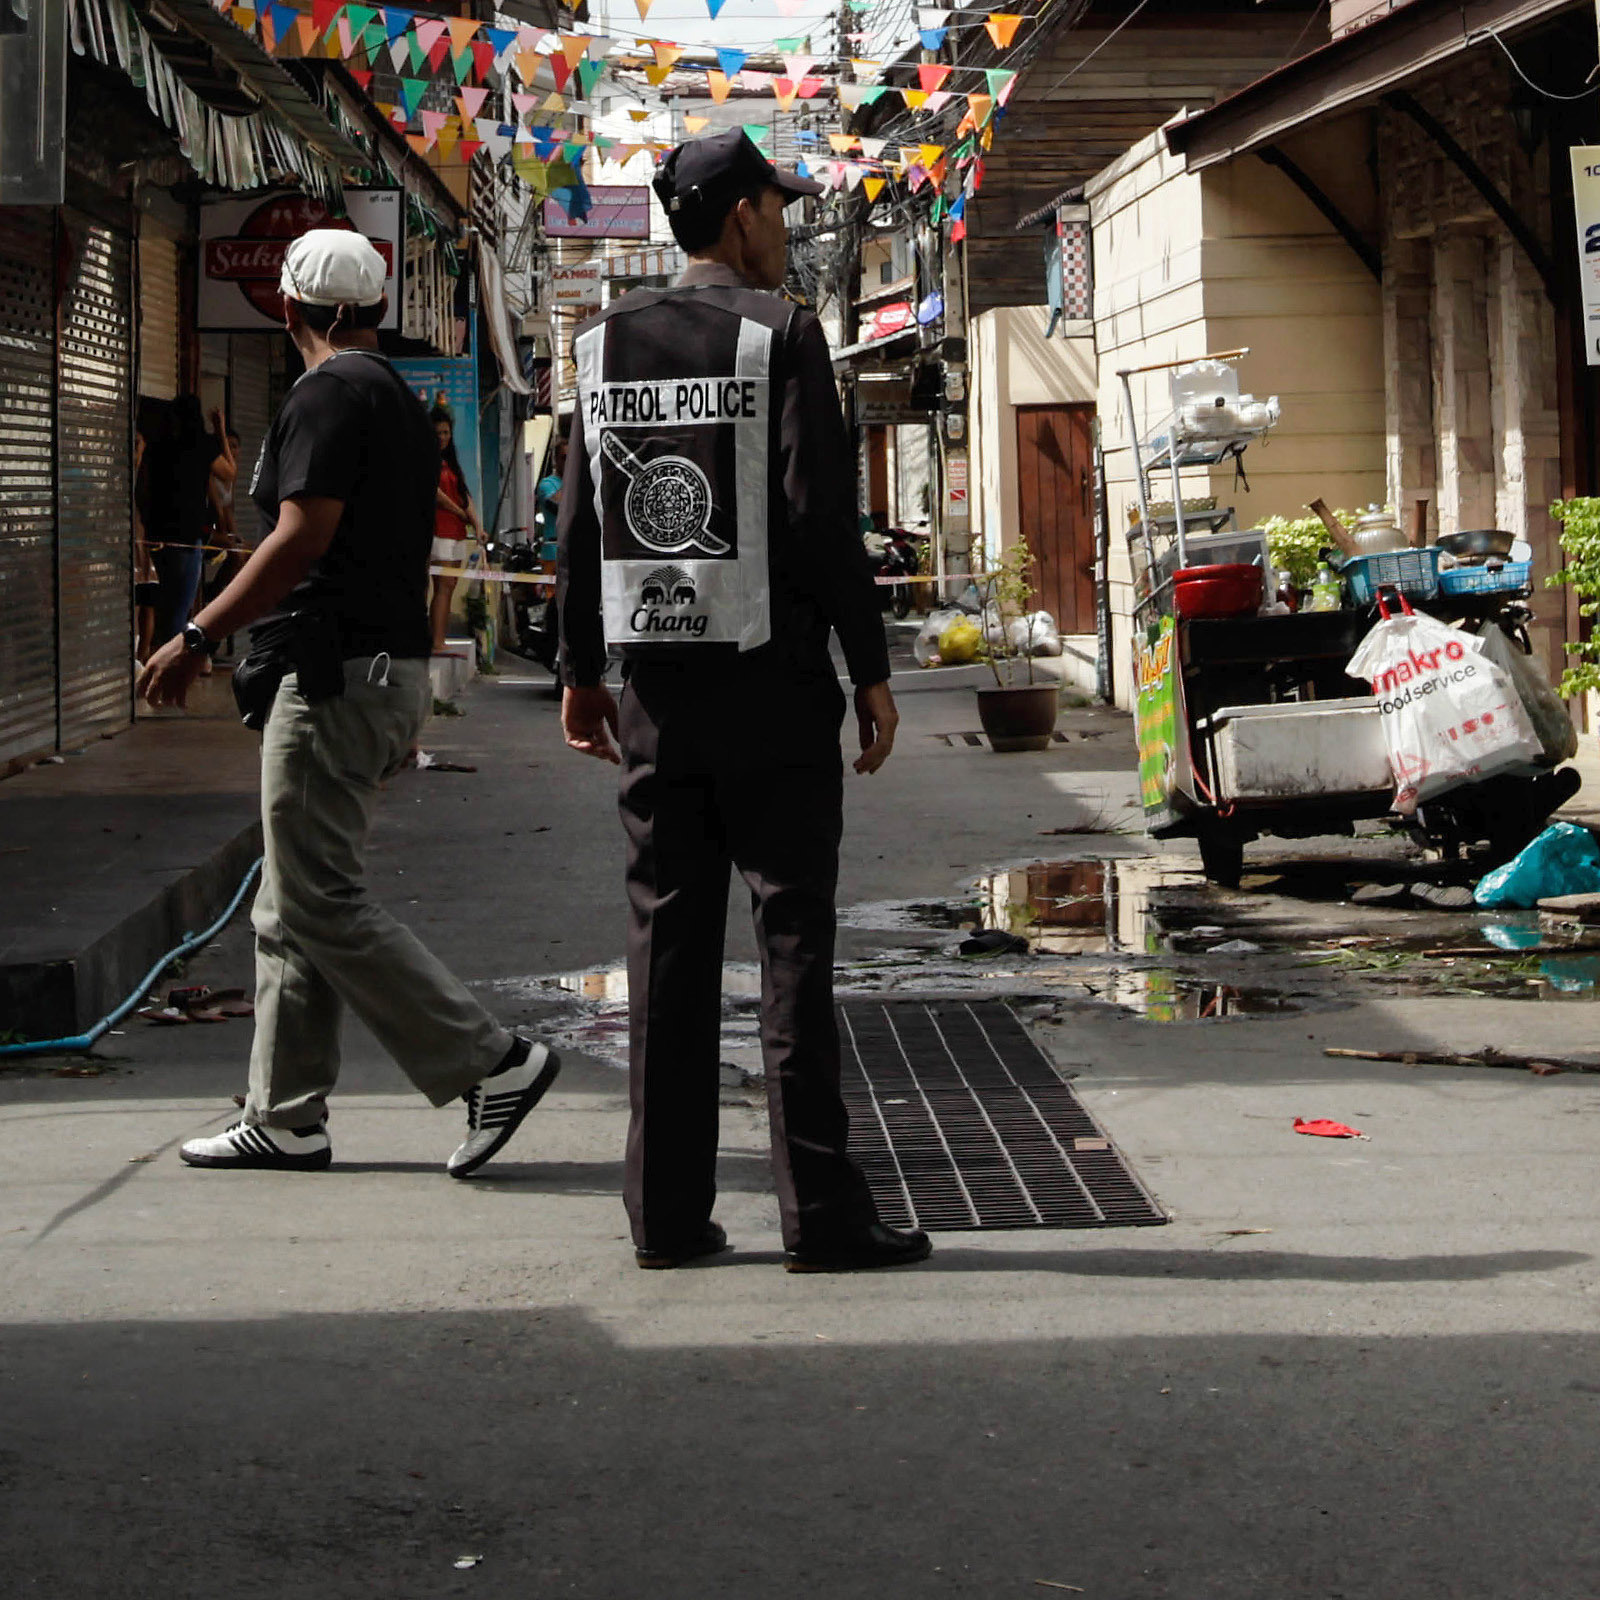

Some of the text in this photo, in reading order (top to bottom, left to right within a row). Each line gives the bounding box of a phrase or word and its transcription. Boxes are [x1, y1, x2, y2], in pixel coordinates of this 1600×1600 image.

[590, 381, 757, 425] PATROL POLICE
[630, 607, 708, 637] Chang
[1372, 640, 1465, 695] makro
